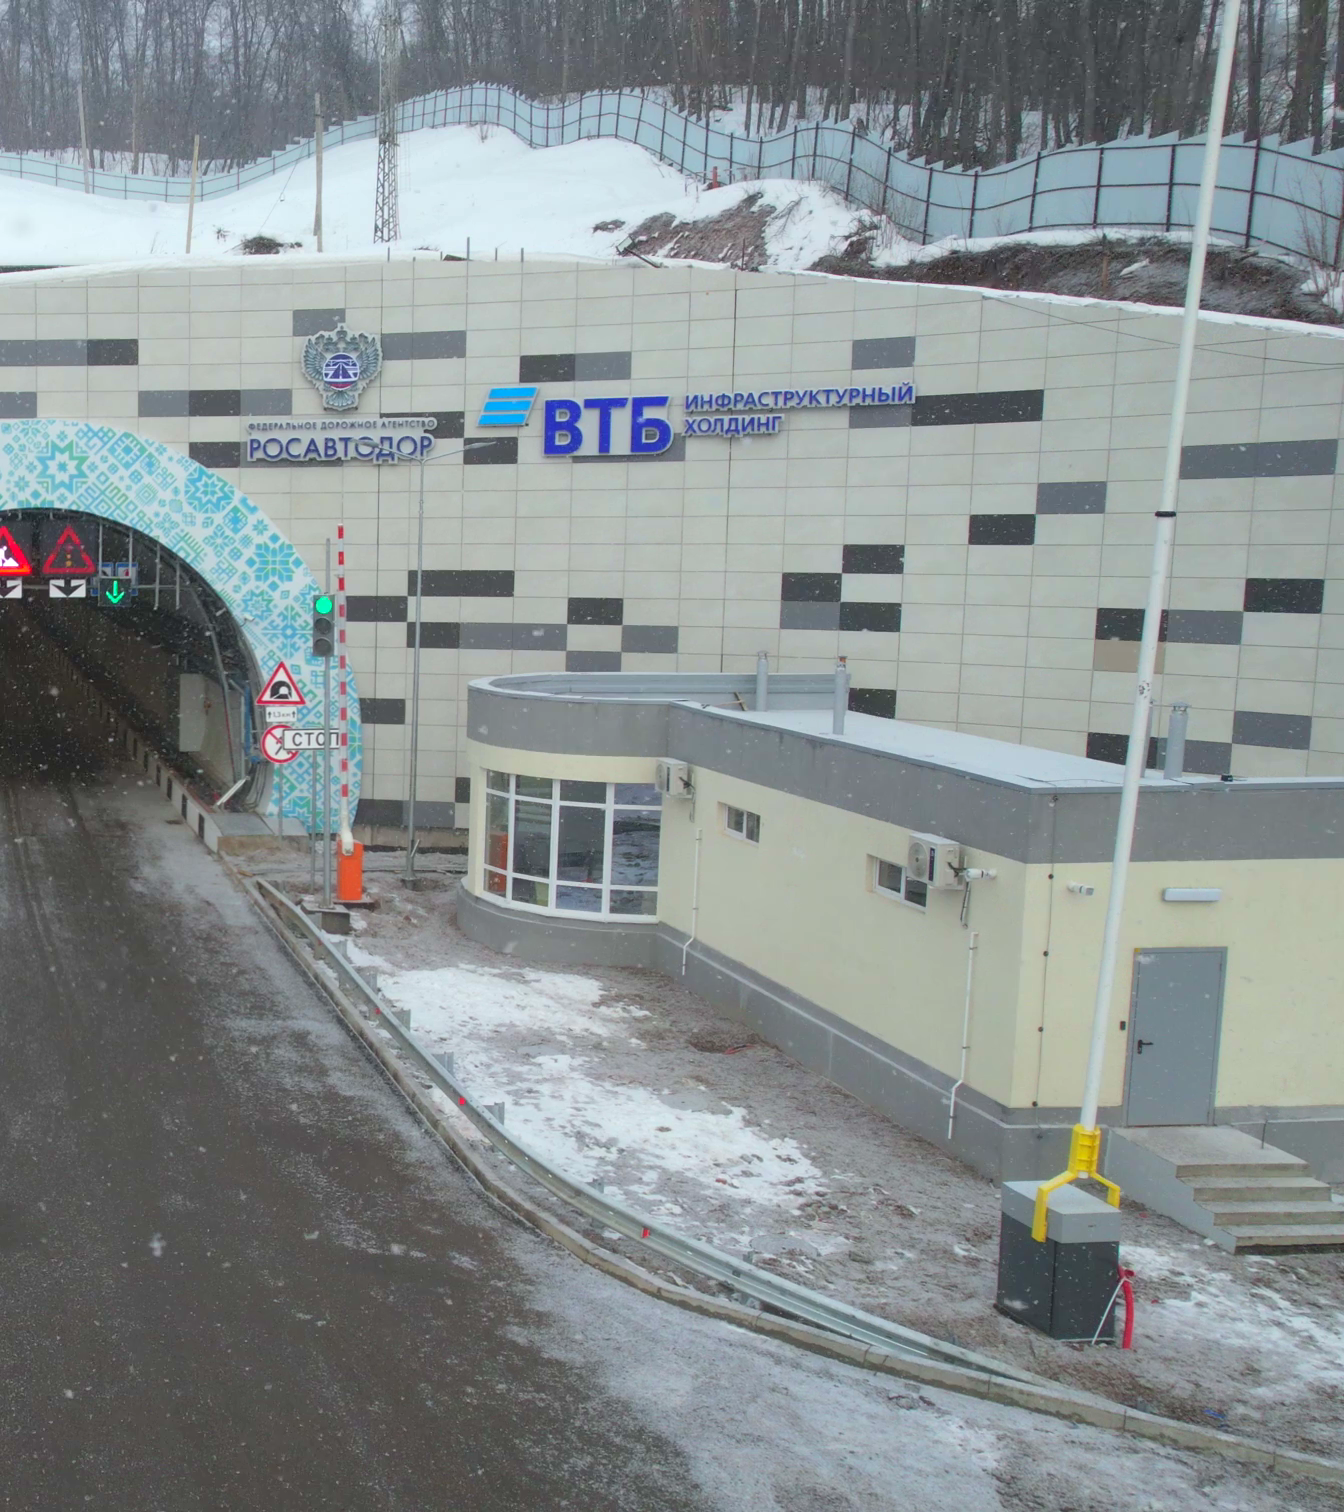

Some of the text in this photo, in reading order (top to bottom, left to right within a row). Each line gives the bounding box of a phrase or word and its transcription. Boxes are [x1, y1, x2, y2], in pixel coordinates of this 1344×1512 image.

[684, 382, 914, 411] ИНФРАСТРУКТУРНЫЙ
[248, 419, 435, 432] ФЕДЕРАЛЬНОЕ ДОРОЖНОЕ АГЕНТСТВО
[543, 396, 674, 456] ВТБ
[684, 415, 783, 436] ХОЛДИНГ
[249, 435, 433, 462] РОСАВТОДОР
[292, 732, 339, 747] СТОП
